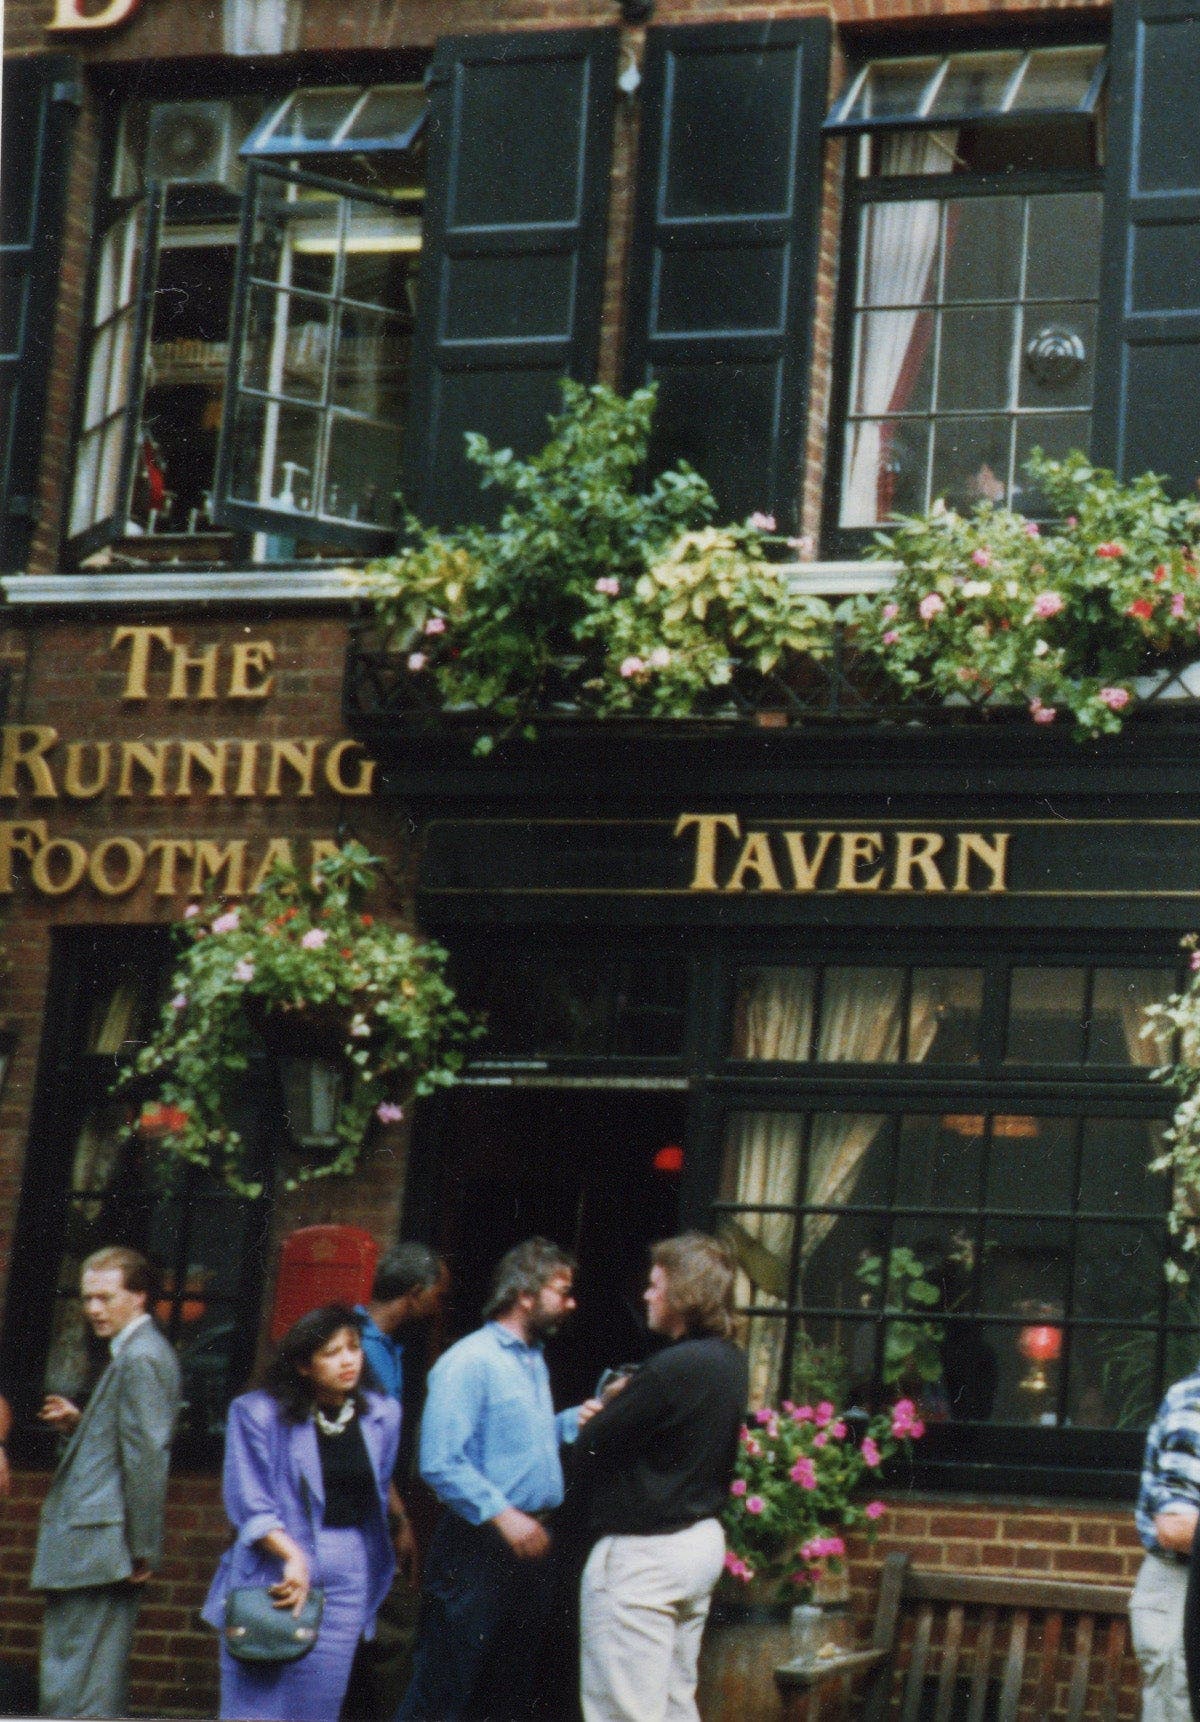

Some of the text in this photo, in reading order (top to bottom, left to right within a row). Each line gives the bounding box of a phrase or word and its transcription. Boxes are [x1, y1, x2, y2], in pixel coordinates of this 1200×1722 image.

[111, 626, 276, 699] THE
[0, 724, 376, 798] RUNNING
[673, 813, 1010, 892] TAVERN
